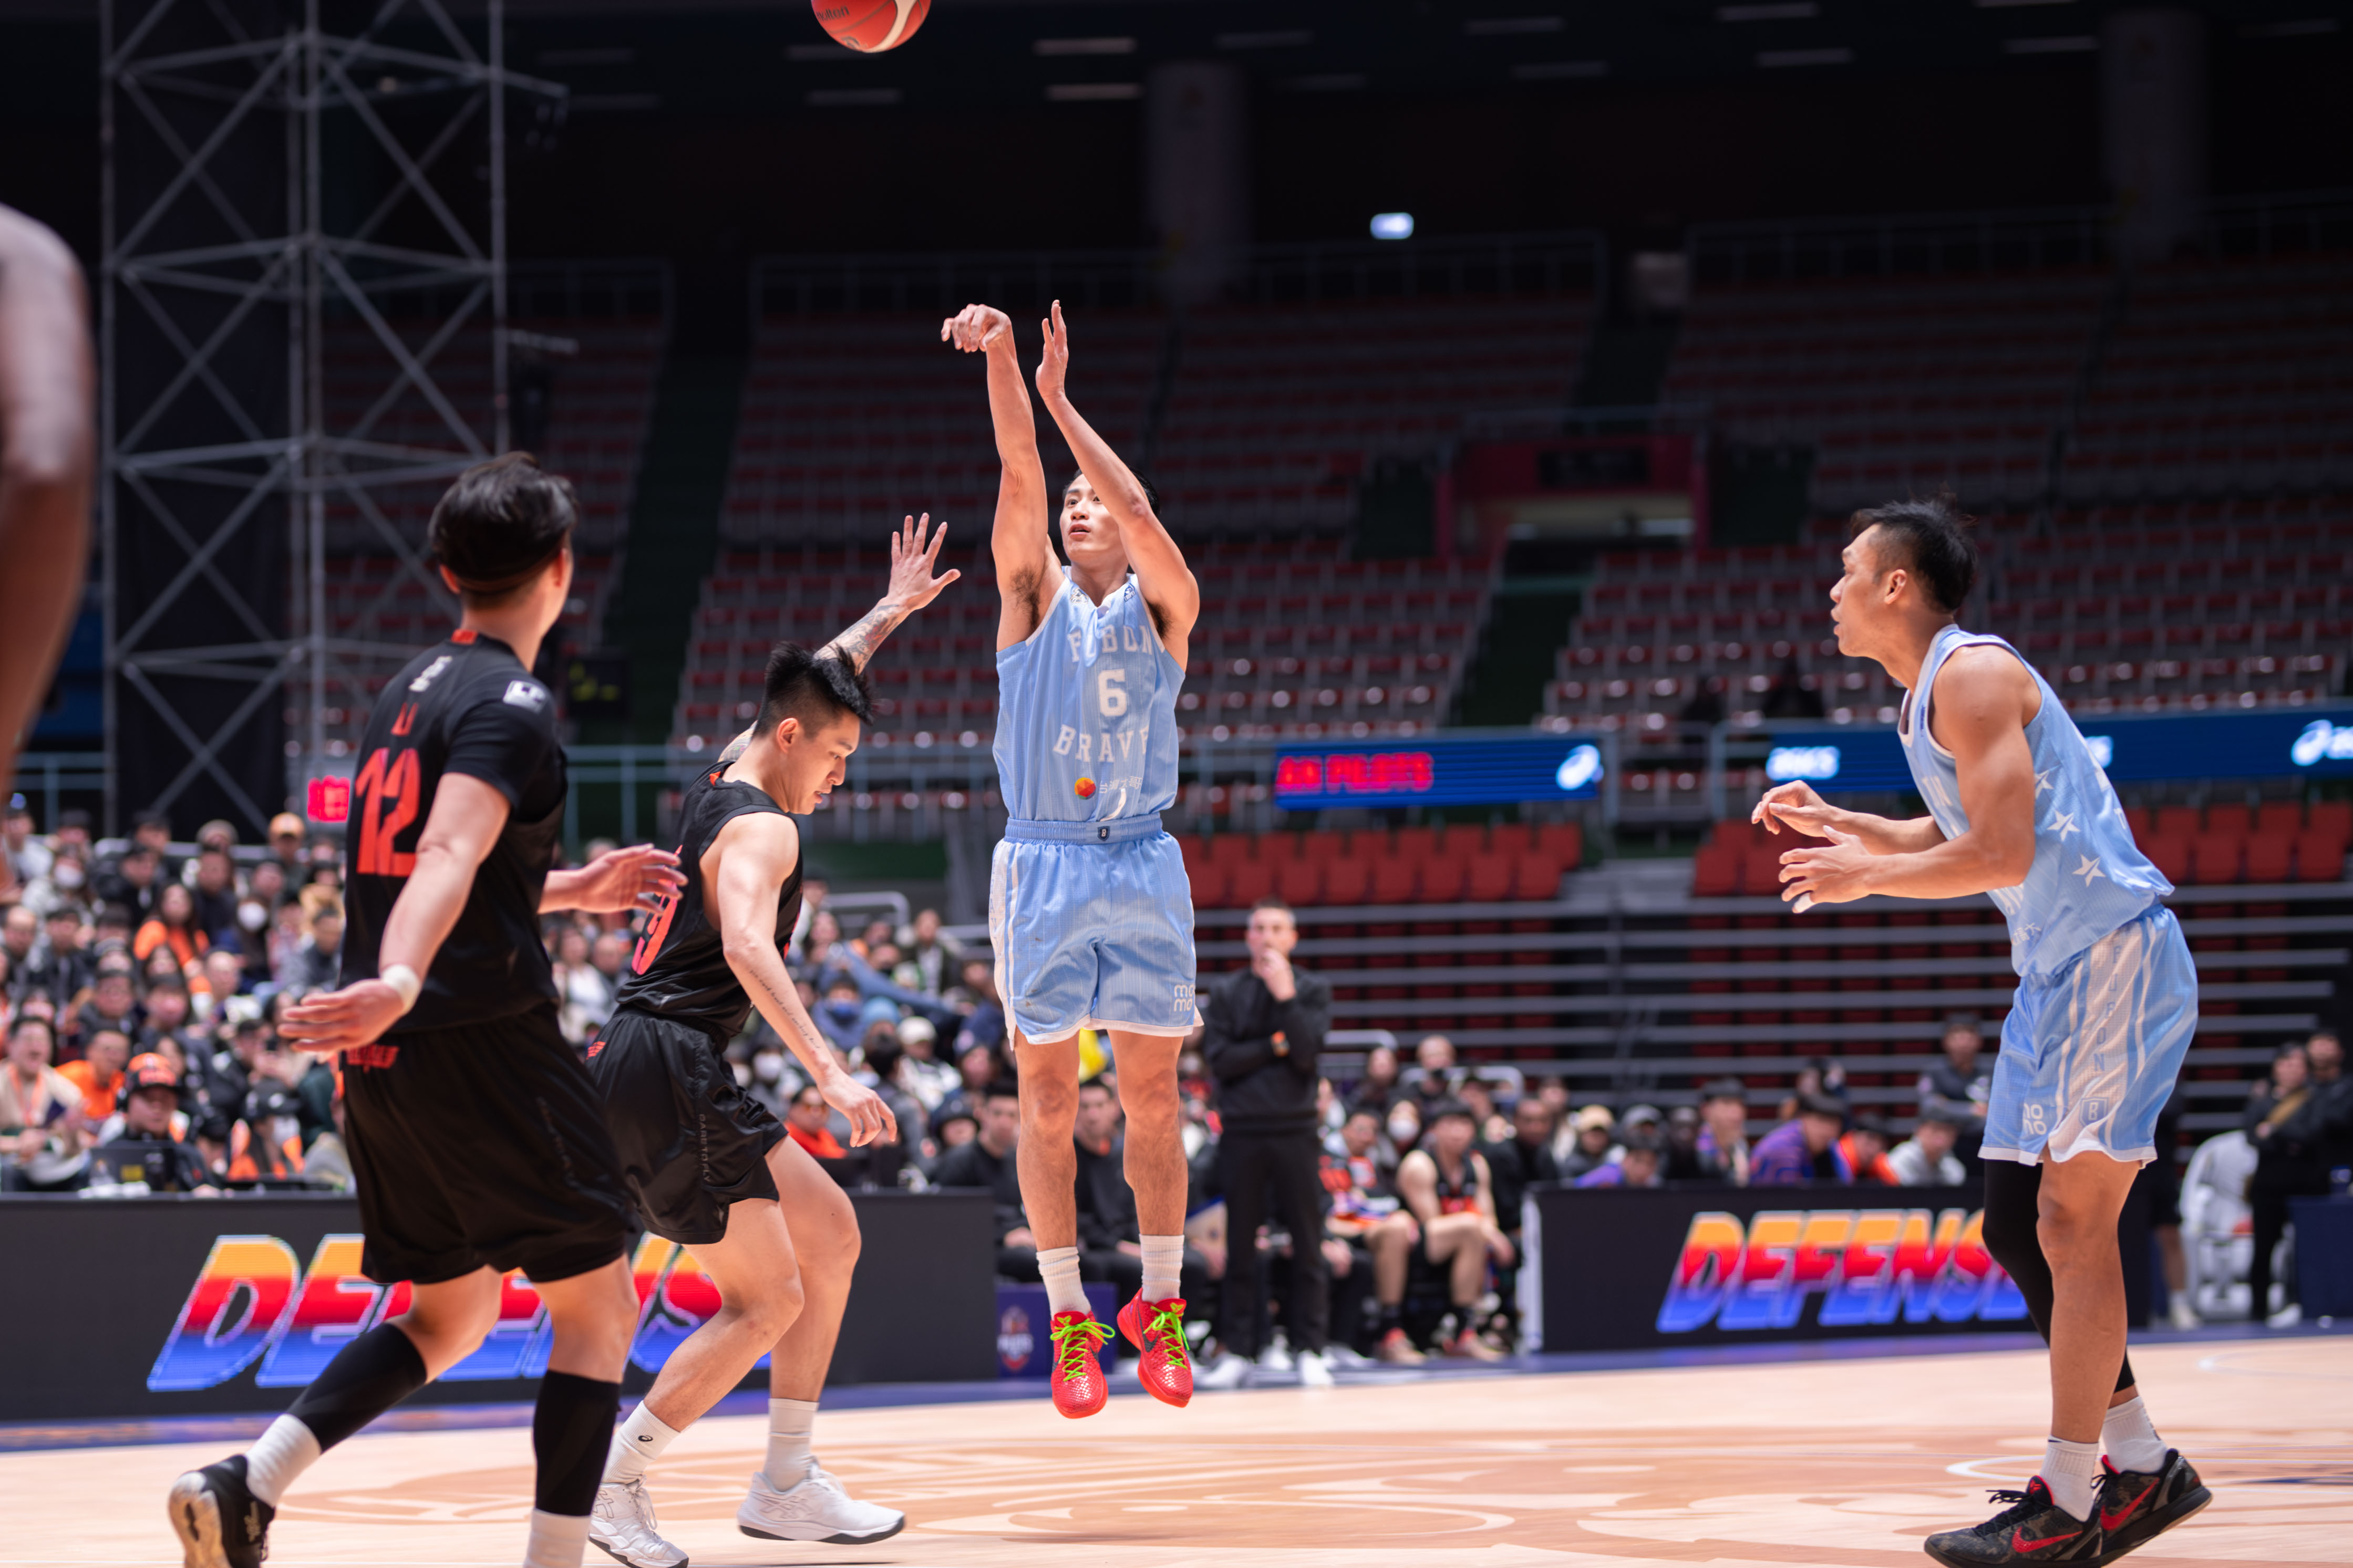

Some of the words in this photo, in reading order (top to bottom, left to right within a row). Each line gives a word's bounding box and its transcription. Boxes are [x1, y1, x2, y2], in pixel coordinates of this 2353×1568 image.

[1098, 668, 1127, 716] 6
[355, 747, 420, 877] 12
[2088, 1102, 2099, 1121] B
[1655, 1208, 2029, 1333] DEFENS
